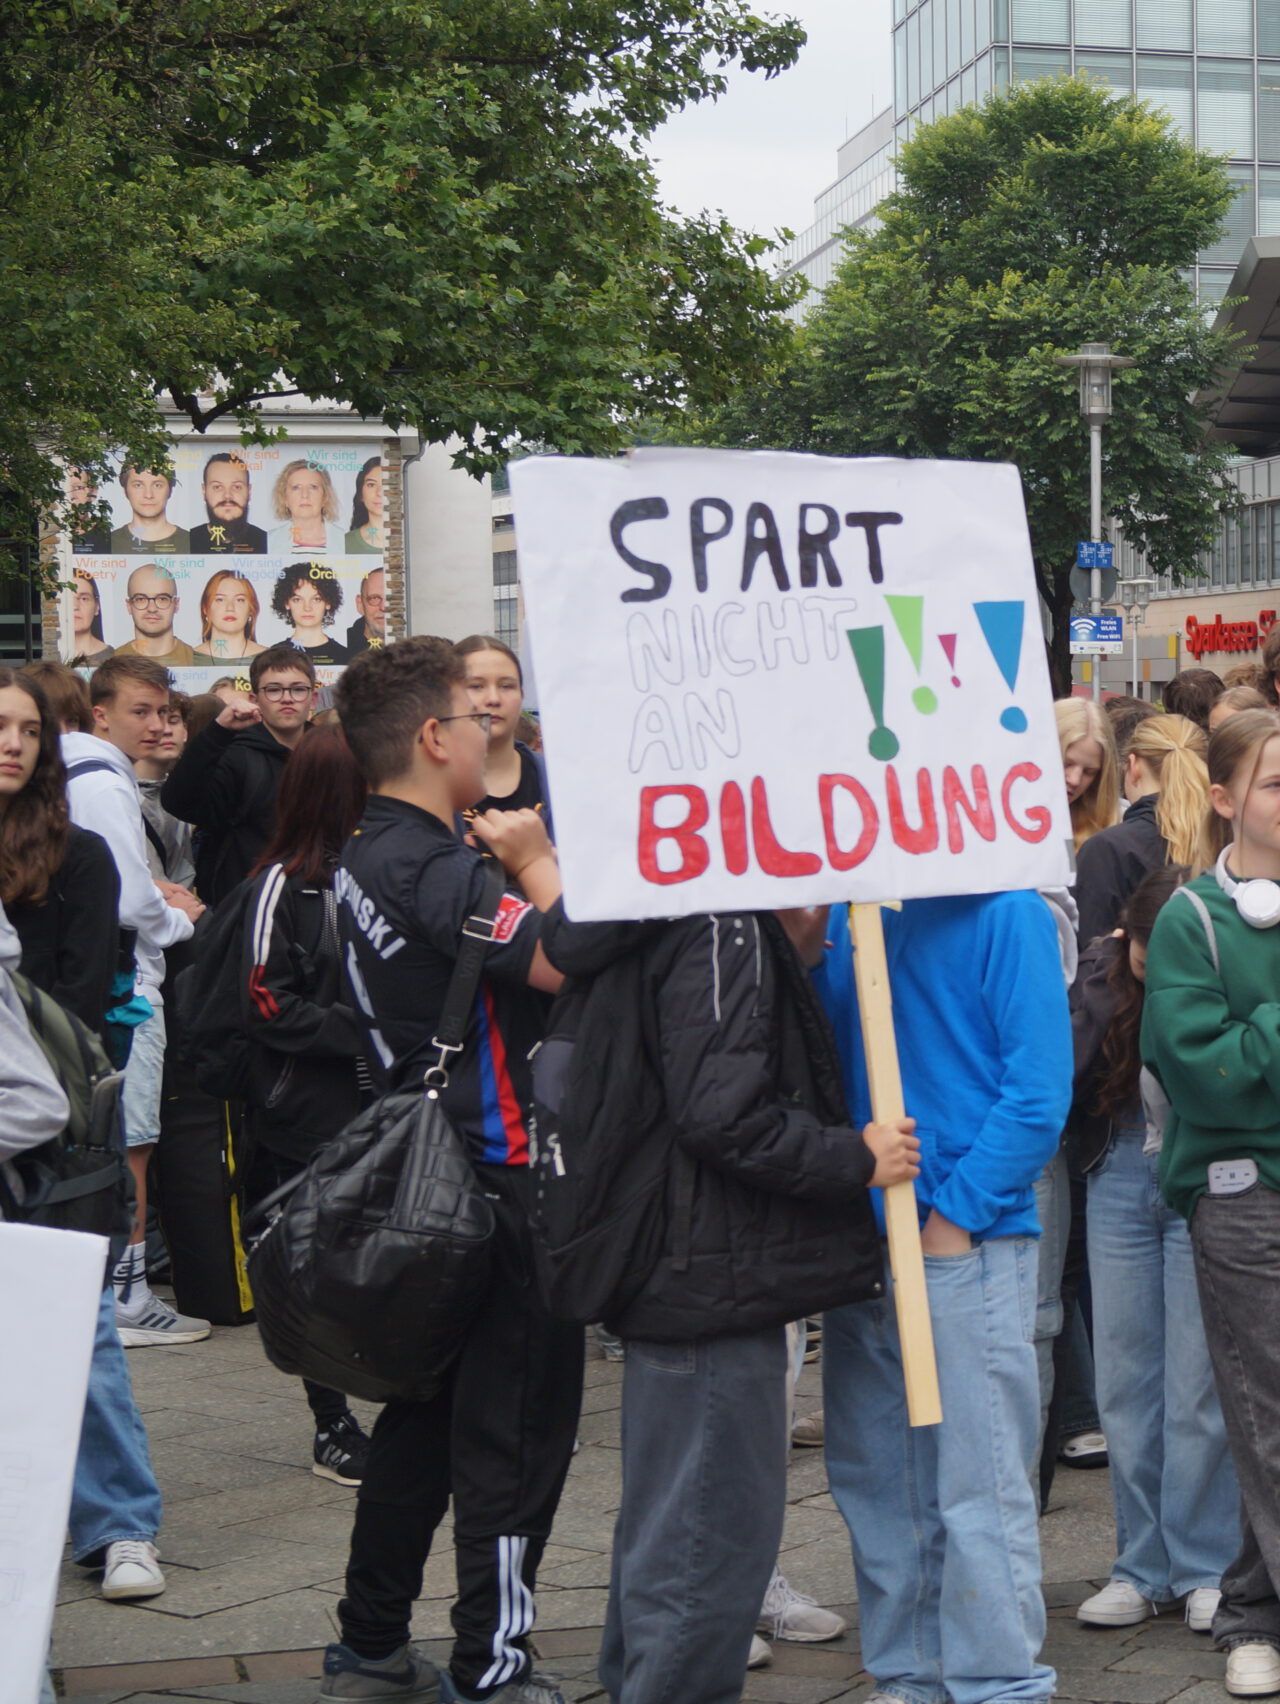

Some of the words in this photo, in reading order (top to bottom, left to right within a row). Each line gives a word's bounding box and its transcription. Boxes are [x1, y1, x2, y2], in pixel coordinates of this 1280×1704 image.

[254, 449, 280, 460] sind
[306, 449, 328, 460] Wir
[332, 449, 357, 460] sind
[608, 496, 903, 603] SPART
[76, 557, 97, 568] Wir
[101, 557, 127, 568] sind
[154, 557, 176, 568] Wir
[180, 557, 205, 568] sind
[232, 557, 254, 568] Wir
[257, 557, 282, 568] sind
[75, 569, 117, 582] Poetry
[626, 595, 858, 692] NICHT
[1185, 614, 1259, 661] Sparkasse
[627, 689, 741, 774] AN
[637, 762, 1053, 886] BILDUNG
